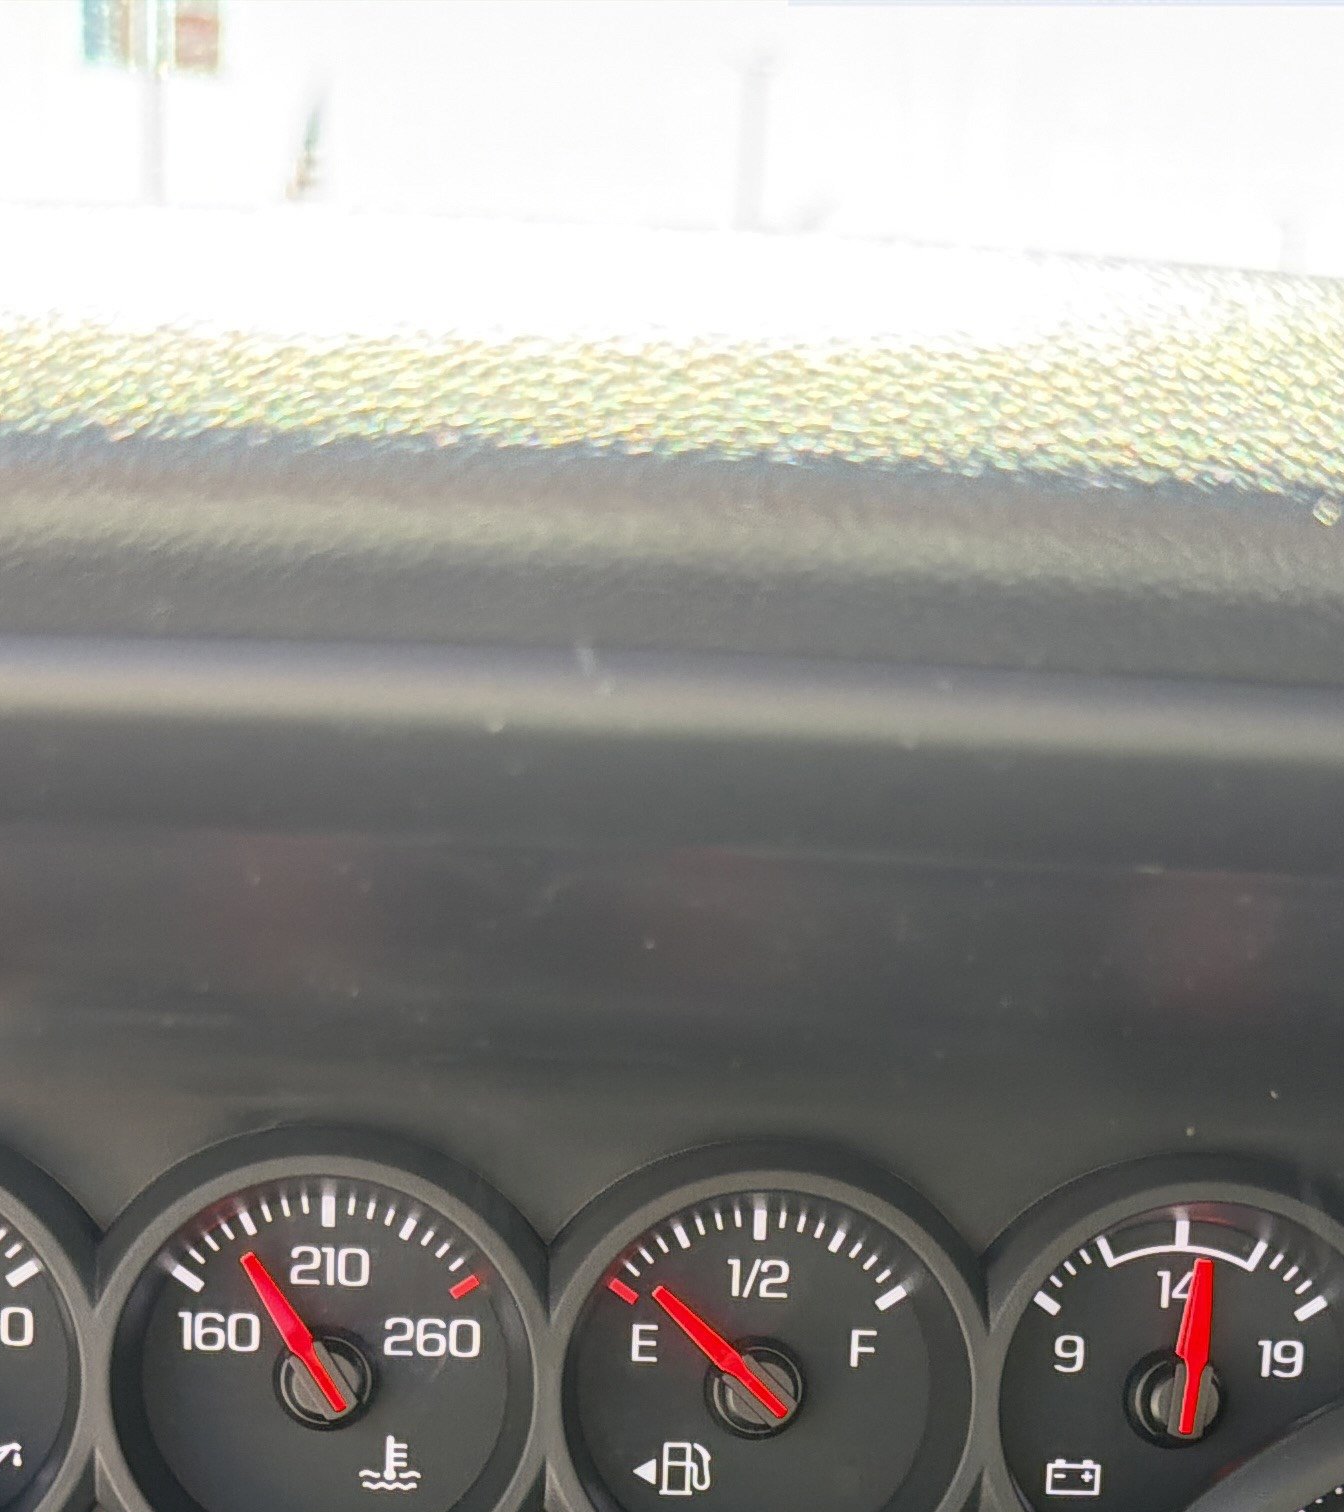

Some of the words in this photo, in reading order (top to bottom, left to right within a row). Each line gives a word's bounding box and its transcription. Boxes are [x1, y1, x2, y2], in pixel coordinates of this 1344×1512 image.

[289, 1245, 370, 1287] 210
[727, 1258, 790, 1299] 1/2
[178, 1311, 261, 1352] 160
[383, 1316, 481, 1358] 260
[631, 1323, 659, 1363] E
[849, 1328, 878, 1368] F
[1053, 1334, 1085, 1373] 9
[1257, 1339, 1304, 1378] 19
